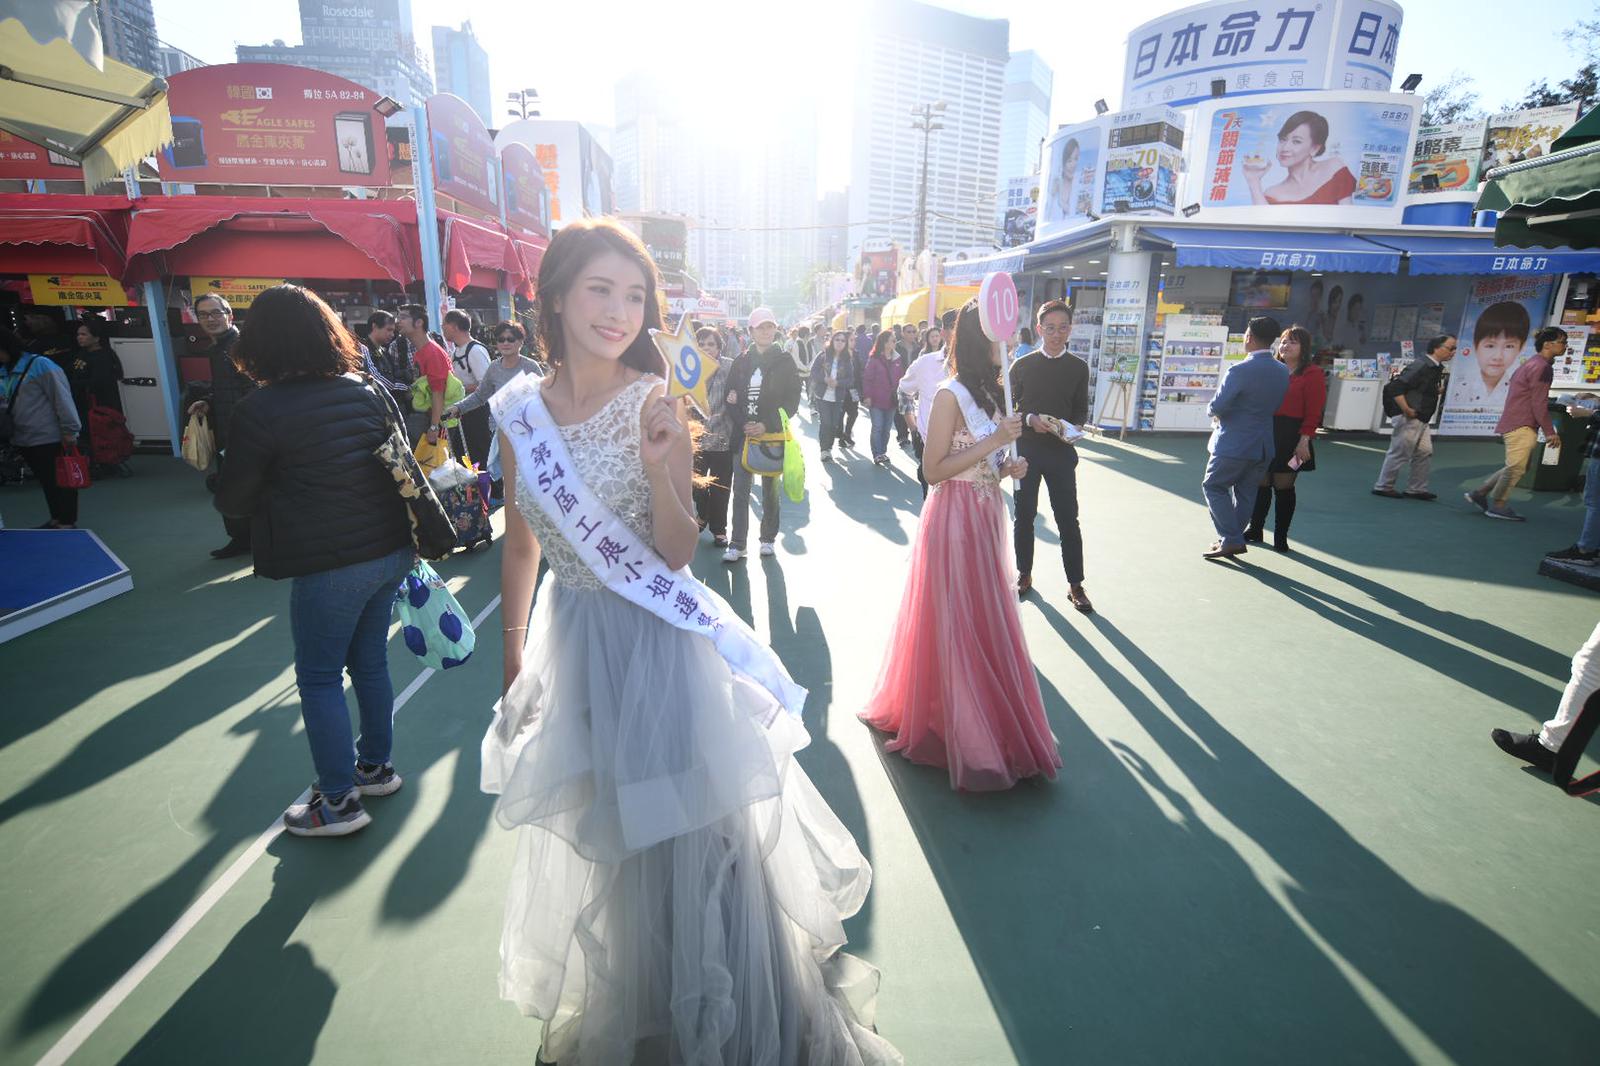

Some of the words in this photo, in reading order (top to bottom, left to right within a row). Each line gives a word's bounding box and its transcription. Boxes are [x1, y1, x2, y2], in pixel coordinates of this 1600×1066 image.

[322, 5, 375, 18] Rosedale
[1132, 7, 1317, 81] 日本命力
[325, 89, 338, 100] 5A
[339, 89, 365, 101] 82-84
[284, 119, 316, 129] SAFES
[1136, 148, 1158, 167] 70
[1260, 252, 1317, 268] 日本命力
[1491, 256, 1549, 271] 日本命力
[992, 288, 1015, 325] 10
[674, 345, 702, 390] 9
